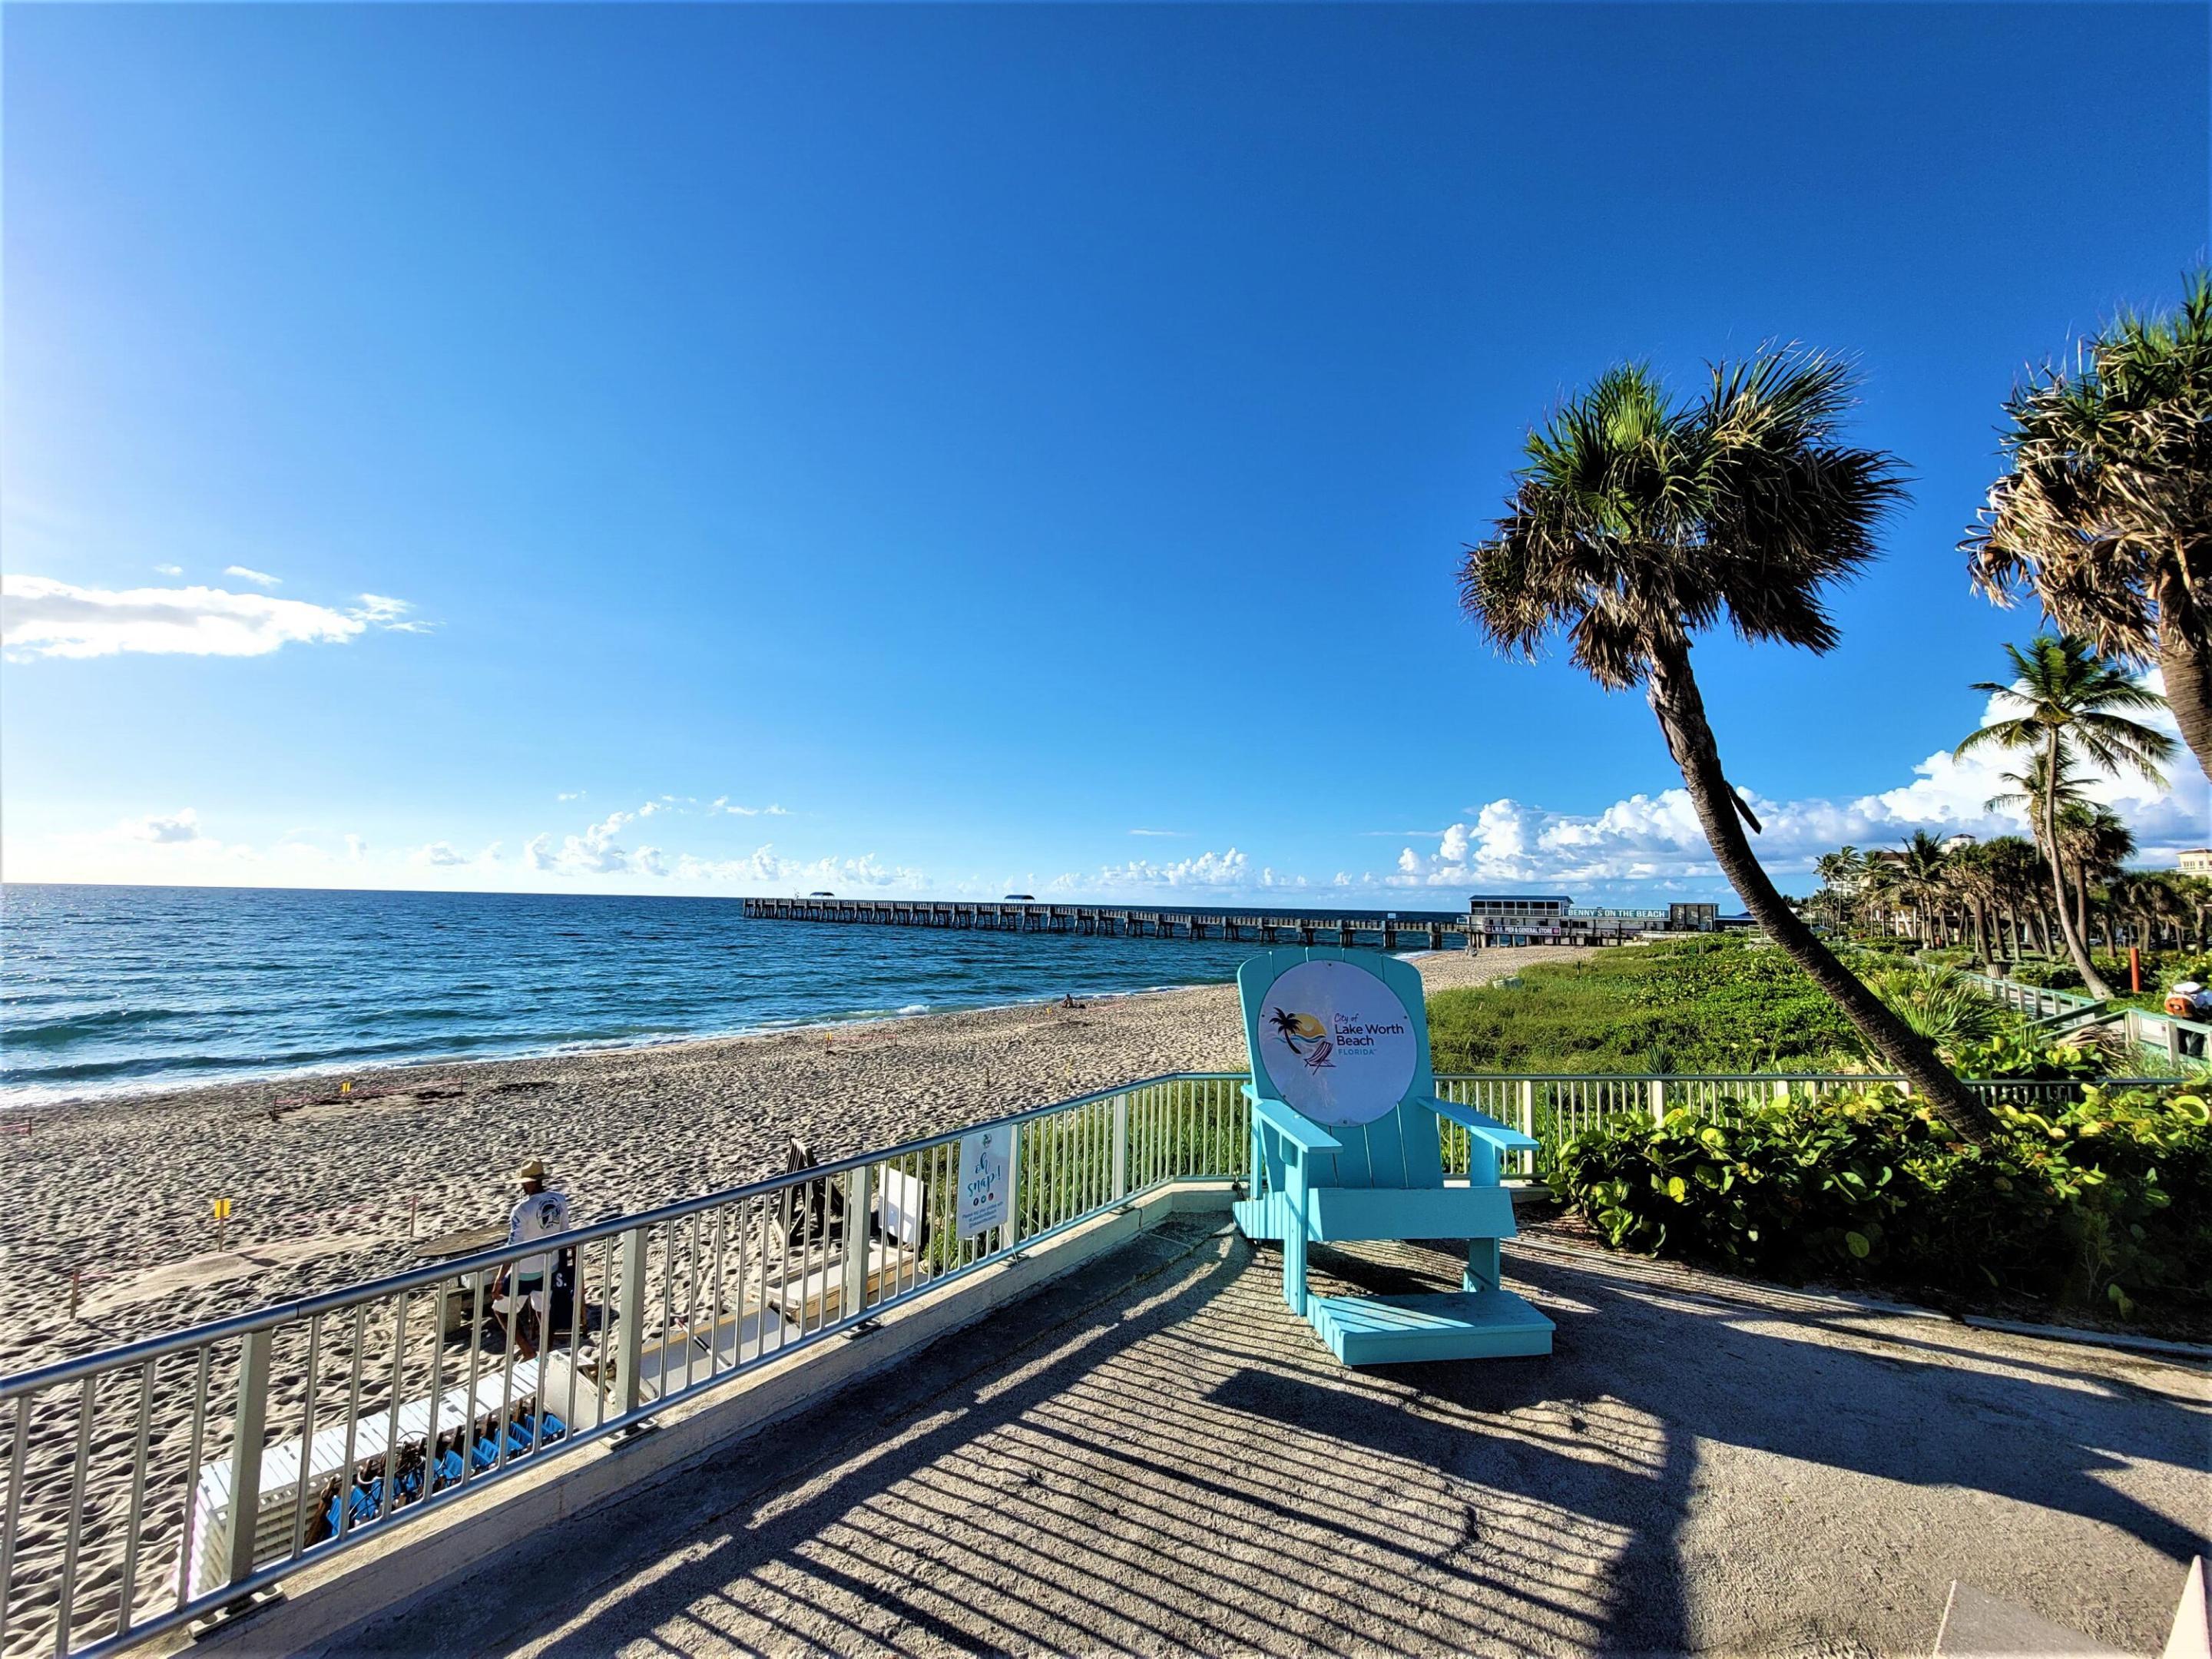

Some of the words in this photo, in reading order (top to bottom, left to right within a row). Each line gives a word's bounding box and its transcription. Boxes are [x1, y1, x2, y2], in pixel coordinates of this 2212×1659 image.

[1334, 1012, 1349, 1024] City
[1351, 1013, 1359, 1022] of
[1334, 1023, 1363, 1035] Lake
[1365, 1023, 1405, 1035] Worth
[1336, 1035, 1374, 1046] Beach
